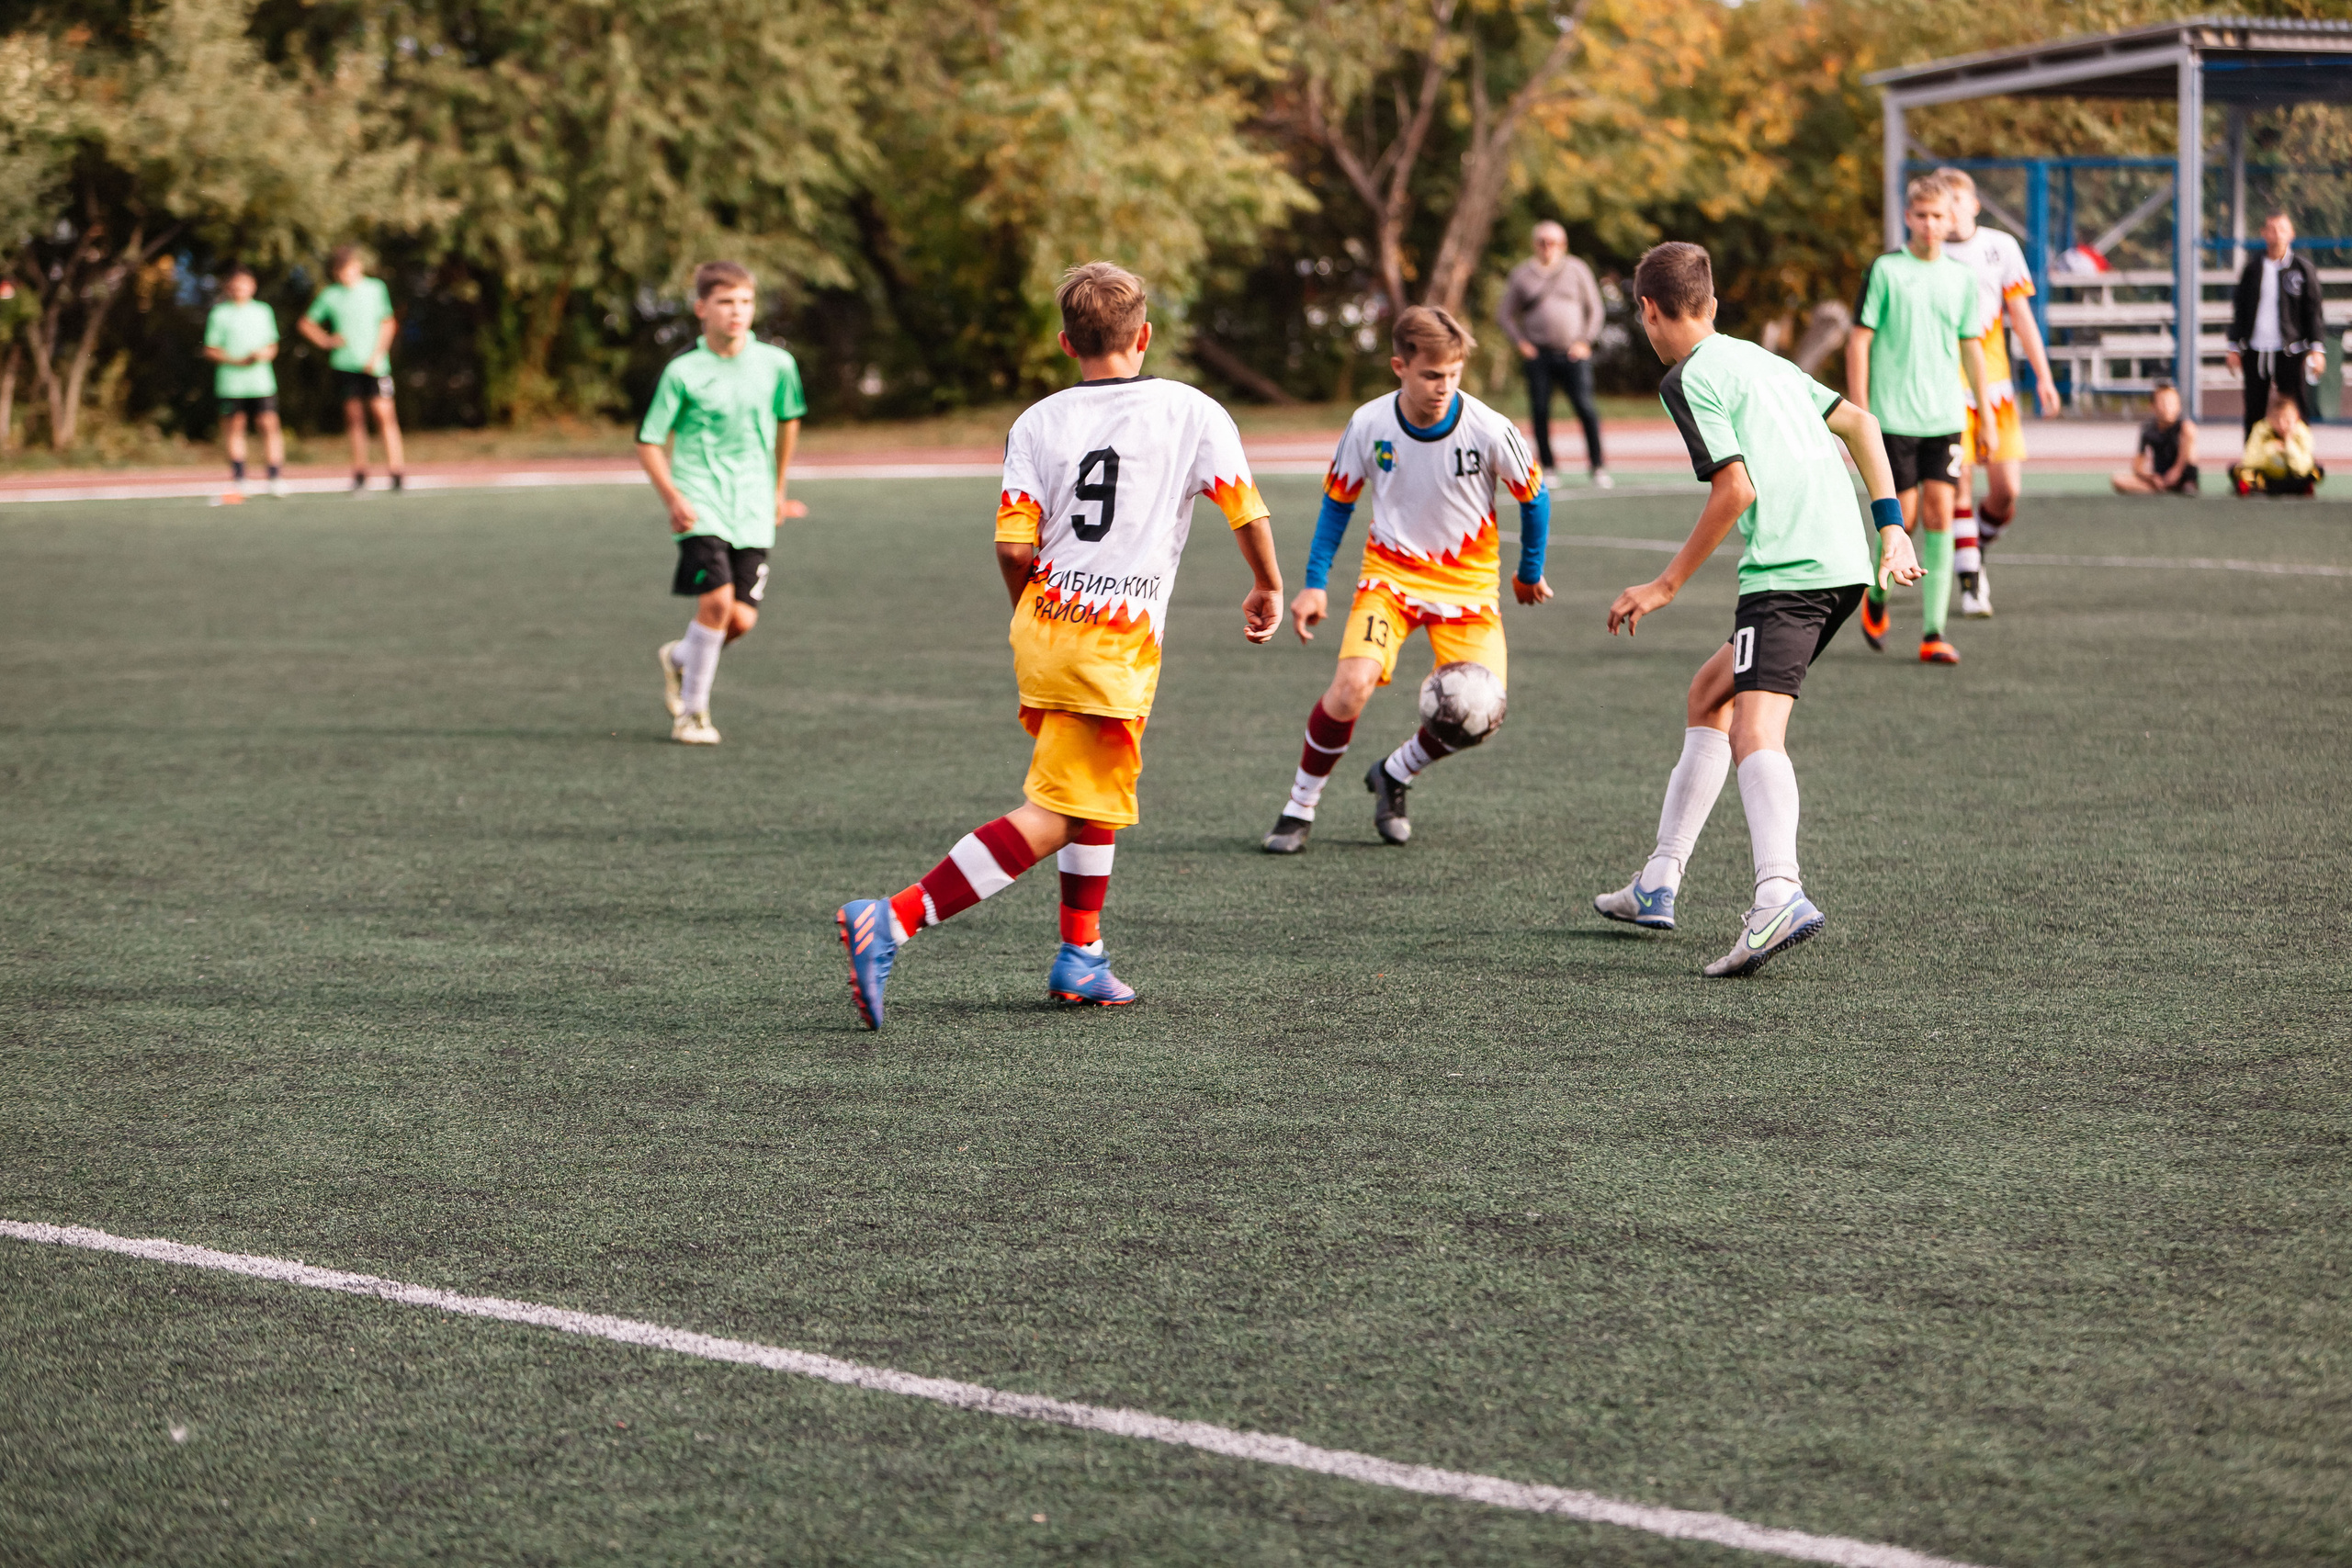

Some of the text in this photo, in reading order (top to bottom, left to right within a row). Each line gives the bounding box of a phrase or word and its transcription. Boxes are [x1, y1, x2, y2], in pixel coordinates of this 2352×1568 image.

[1454, 447, 1480, 477] 13
[1070, 445, 1120, 542] 9
[1034, 595, 1101, 625] РАЙОН
[1363, 615, 1388, 648] 13
